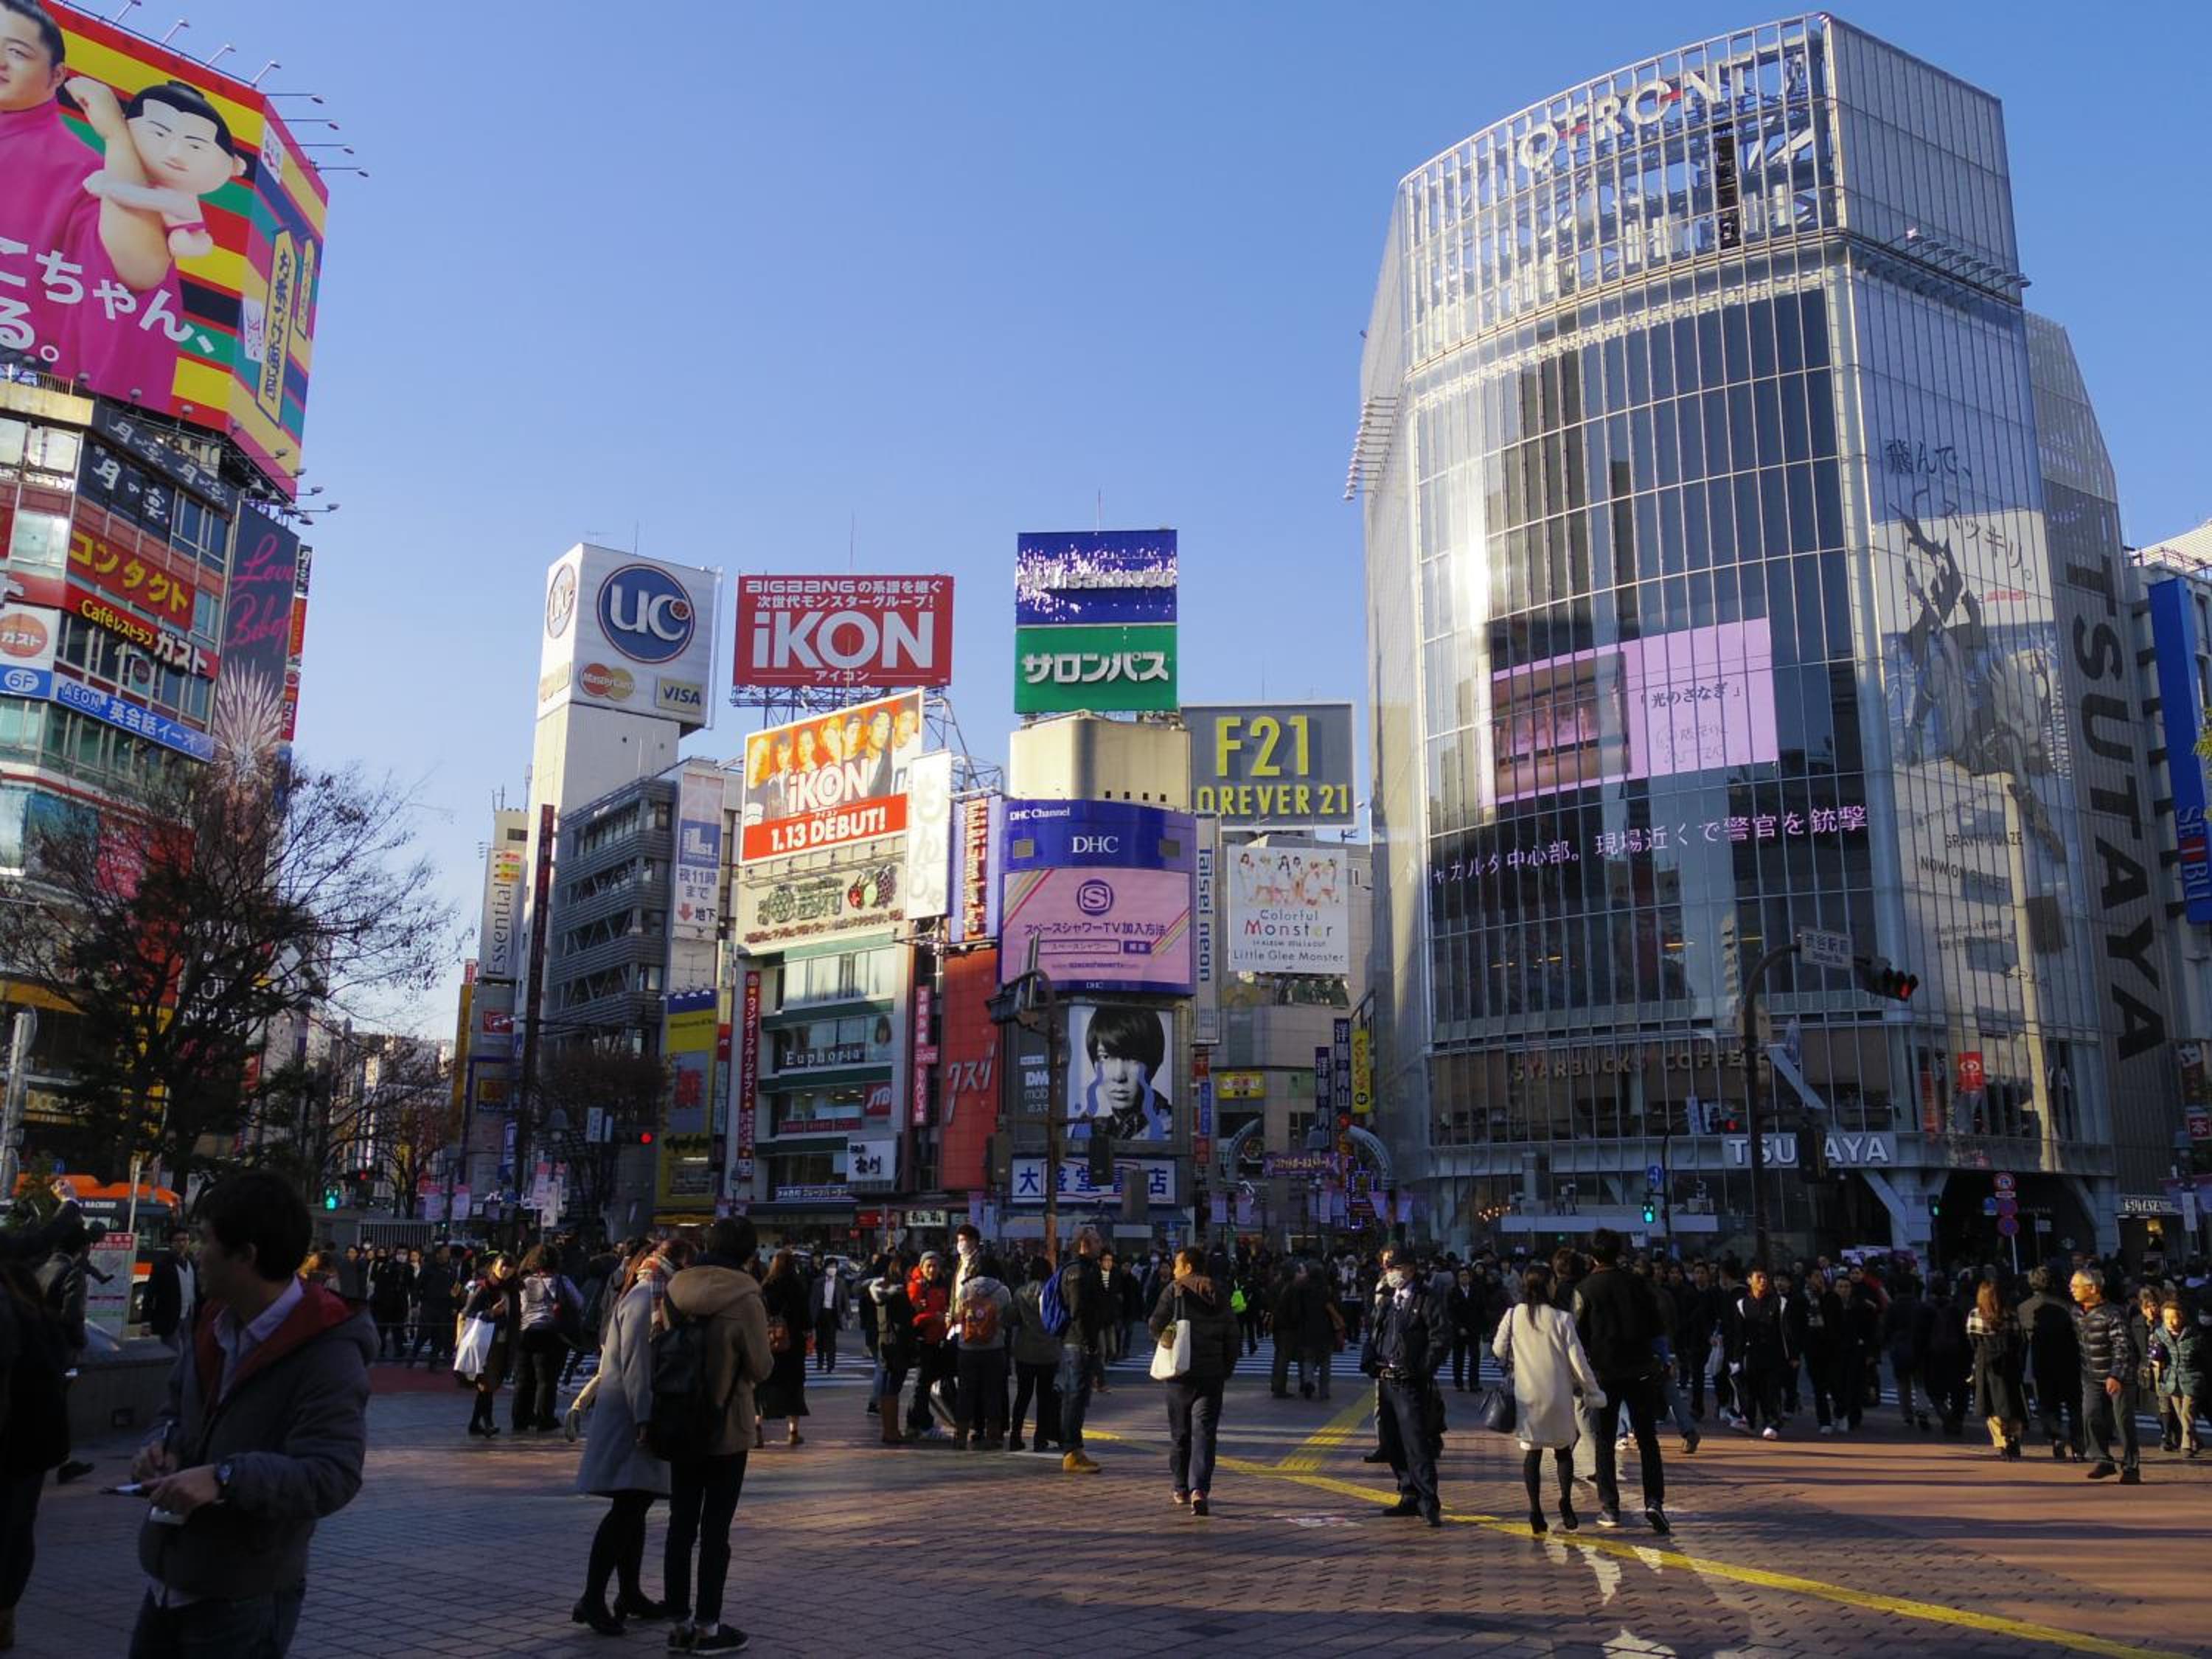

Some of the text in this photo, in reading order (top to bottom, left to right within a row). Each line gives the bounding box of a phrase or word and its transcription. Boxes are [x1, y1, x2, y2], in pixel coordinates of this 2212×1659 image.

[69, 531, 190, 613] コンタクト
[746, 580, 944, 594] BIGBANGの系譜を継ぐ
[1, 632, 41, 647] ガスト
[753, 611, 933, 669] iKON
[154, 630, 209, 675] ガスト
[9, 672, 35, 688] 6F
[815, 669, 869, 682] アイコン
[1022, 651, 1169, 684] サロンパス
[63, 683, 102, 709] AEON
[664, 683, 700, 707] VISA
[1215, 715, 1310, 777] F21
[789, 759, 869, 814] iKON
[1197, 784, 1348, 815] OREVER 21
[2067, 554, 2165, 1060] TSUTAYA
[771, 808, 886, 852] 1.13 DEBUT!
[1072, 836, 1119, 854] DHC
[2177, 805, 2211, 900] SEIBU
[685, 885, 710, 900] まで
[695, 907, 717, 922] 地下
[1198, 848, 1214, 982] Taisei neon
[1260, 909, 1318, 921] Colorful
[487, 882, 511, 978] Essential
[1245, 919, 1333, 938] Monster
[1234, 950, 1344, 962] Little Glee Monster
[786, 1048, 861, 1068] Euphoria
[867, 1086, 891, 1110] JTB
